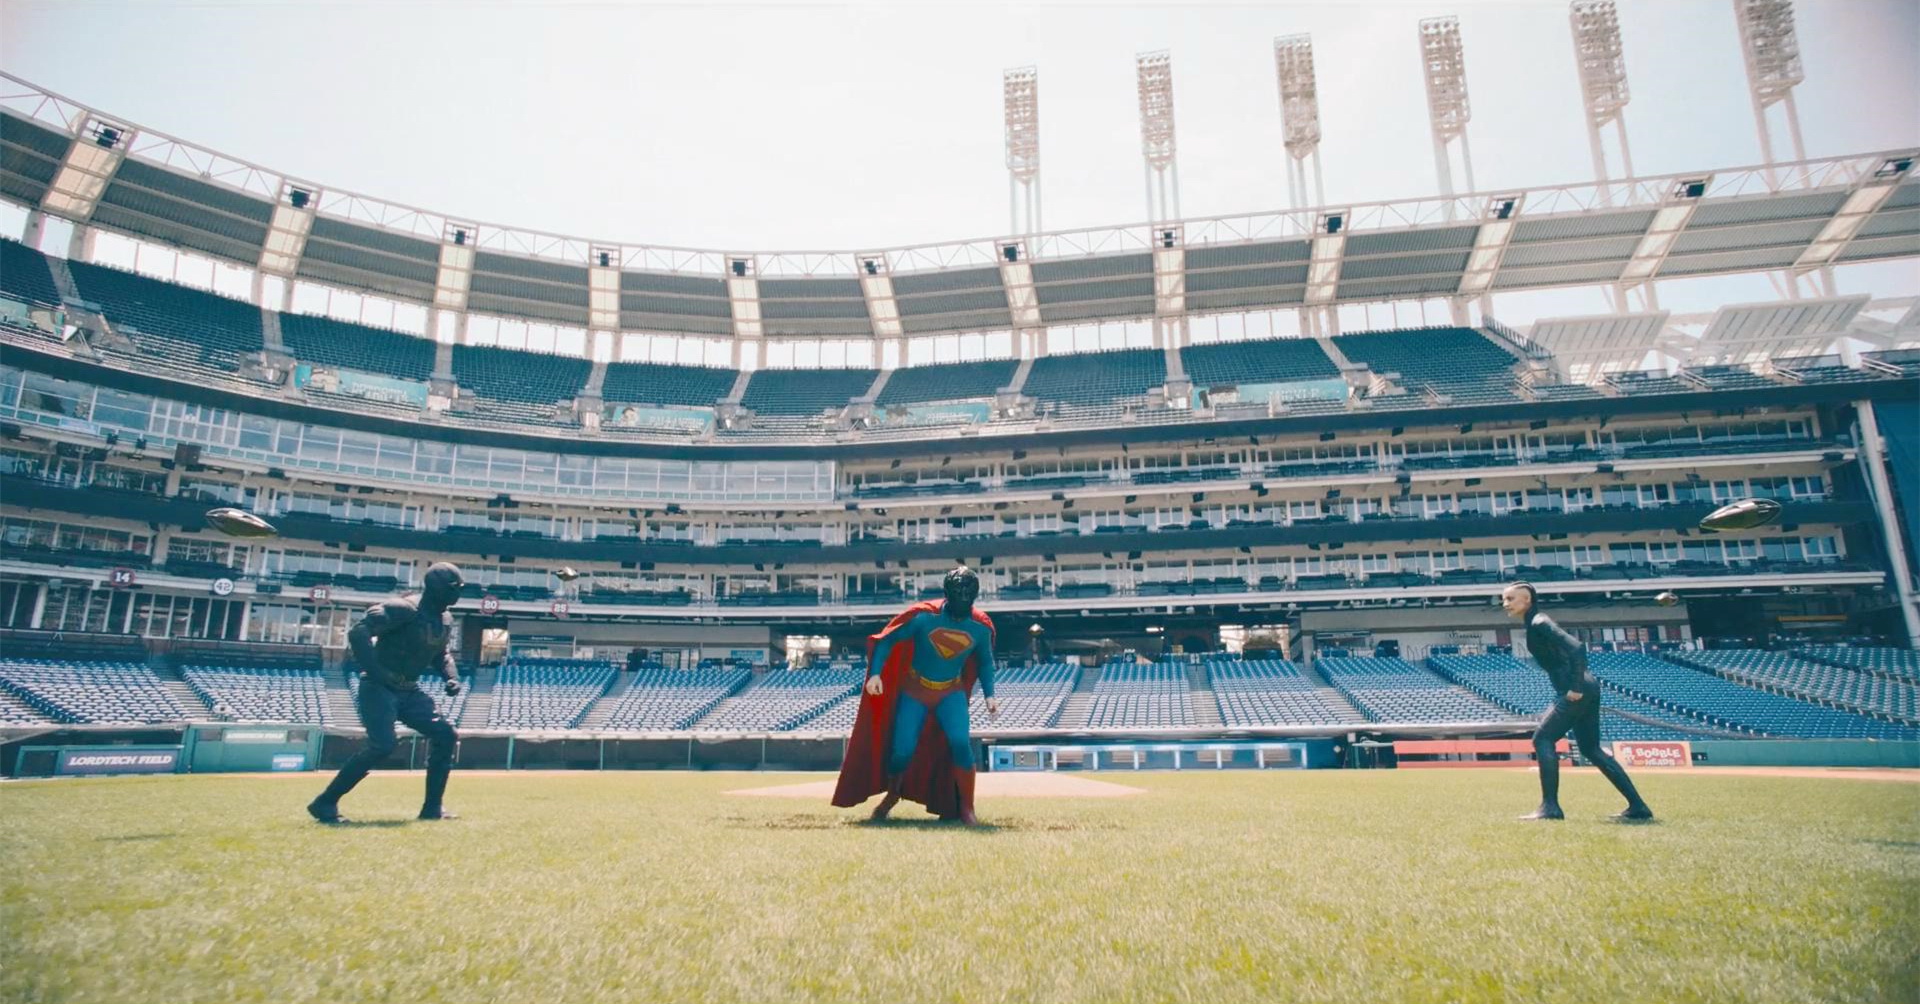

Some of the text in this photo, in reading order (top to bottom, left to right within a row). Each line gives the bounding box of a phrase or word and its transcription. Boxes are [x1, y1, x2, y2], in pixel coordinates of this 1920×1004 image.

[115, 572, 130, 582] 14
[215, 582, 231, 591] 42
[484, 601, 497, 610] 20
[1636, 748, 1681, 758] BOBBLE
[68, 755, 172, 766] LORDTECH FIELD
